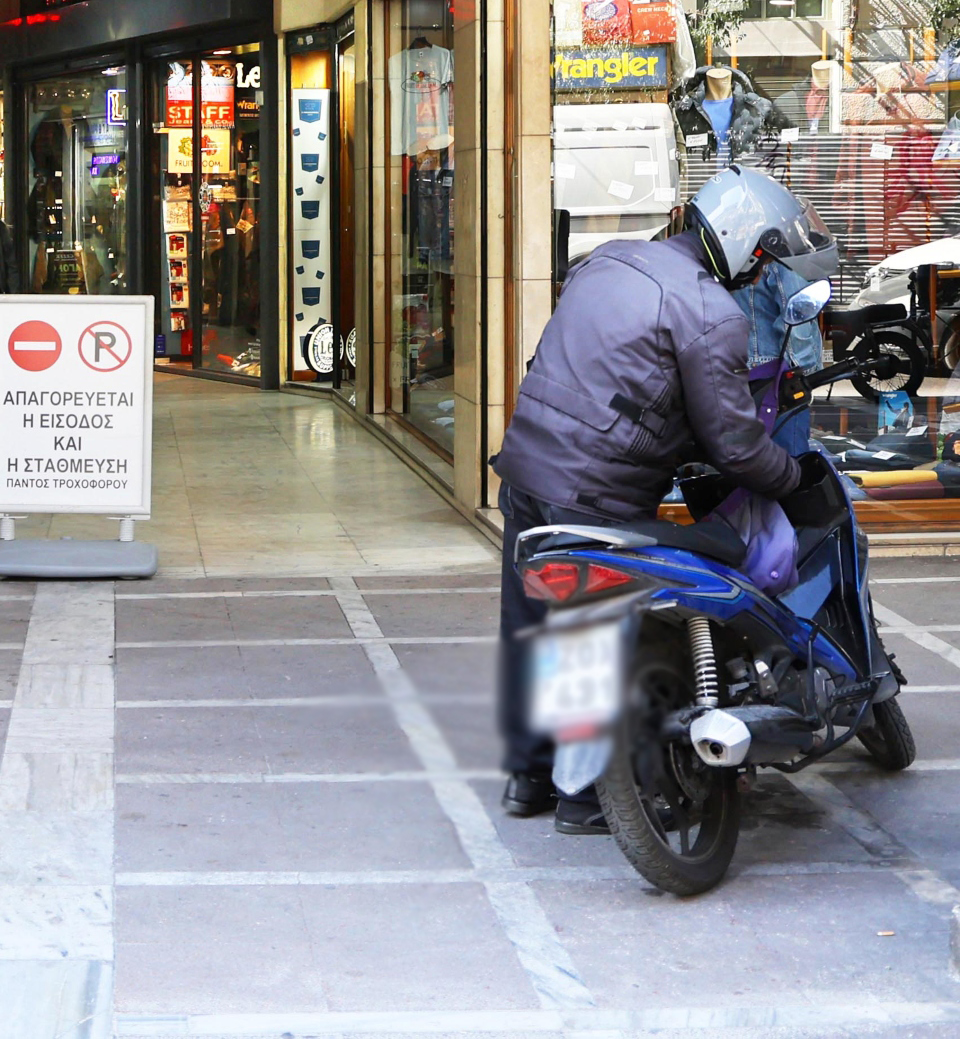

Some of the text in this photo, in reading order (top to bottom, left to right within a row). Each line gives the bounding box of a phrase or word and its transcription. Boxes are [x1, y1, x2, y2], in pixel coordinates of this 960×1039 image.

[3, 391, 134, 407] ΑΠΑΓΟΡΕΥΕΤΑΙ
[23, 413, 114, 429] Η ΕΙΣΟΔΟΣ
[53, 436, 82, 451] ΚΑΙ
[7, 458, 127, 474] Η ΣΤΑΘΜΕΥΣΗ
[6, 478, 128, 490] ΠΑΝΤΟΣ ΤΡΟΧΟΦΟΡΟΥ
